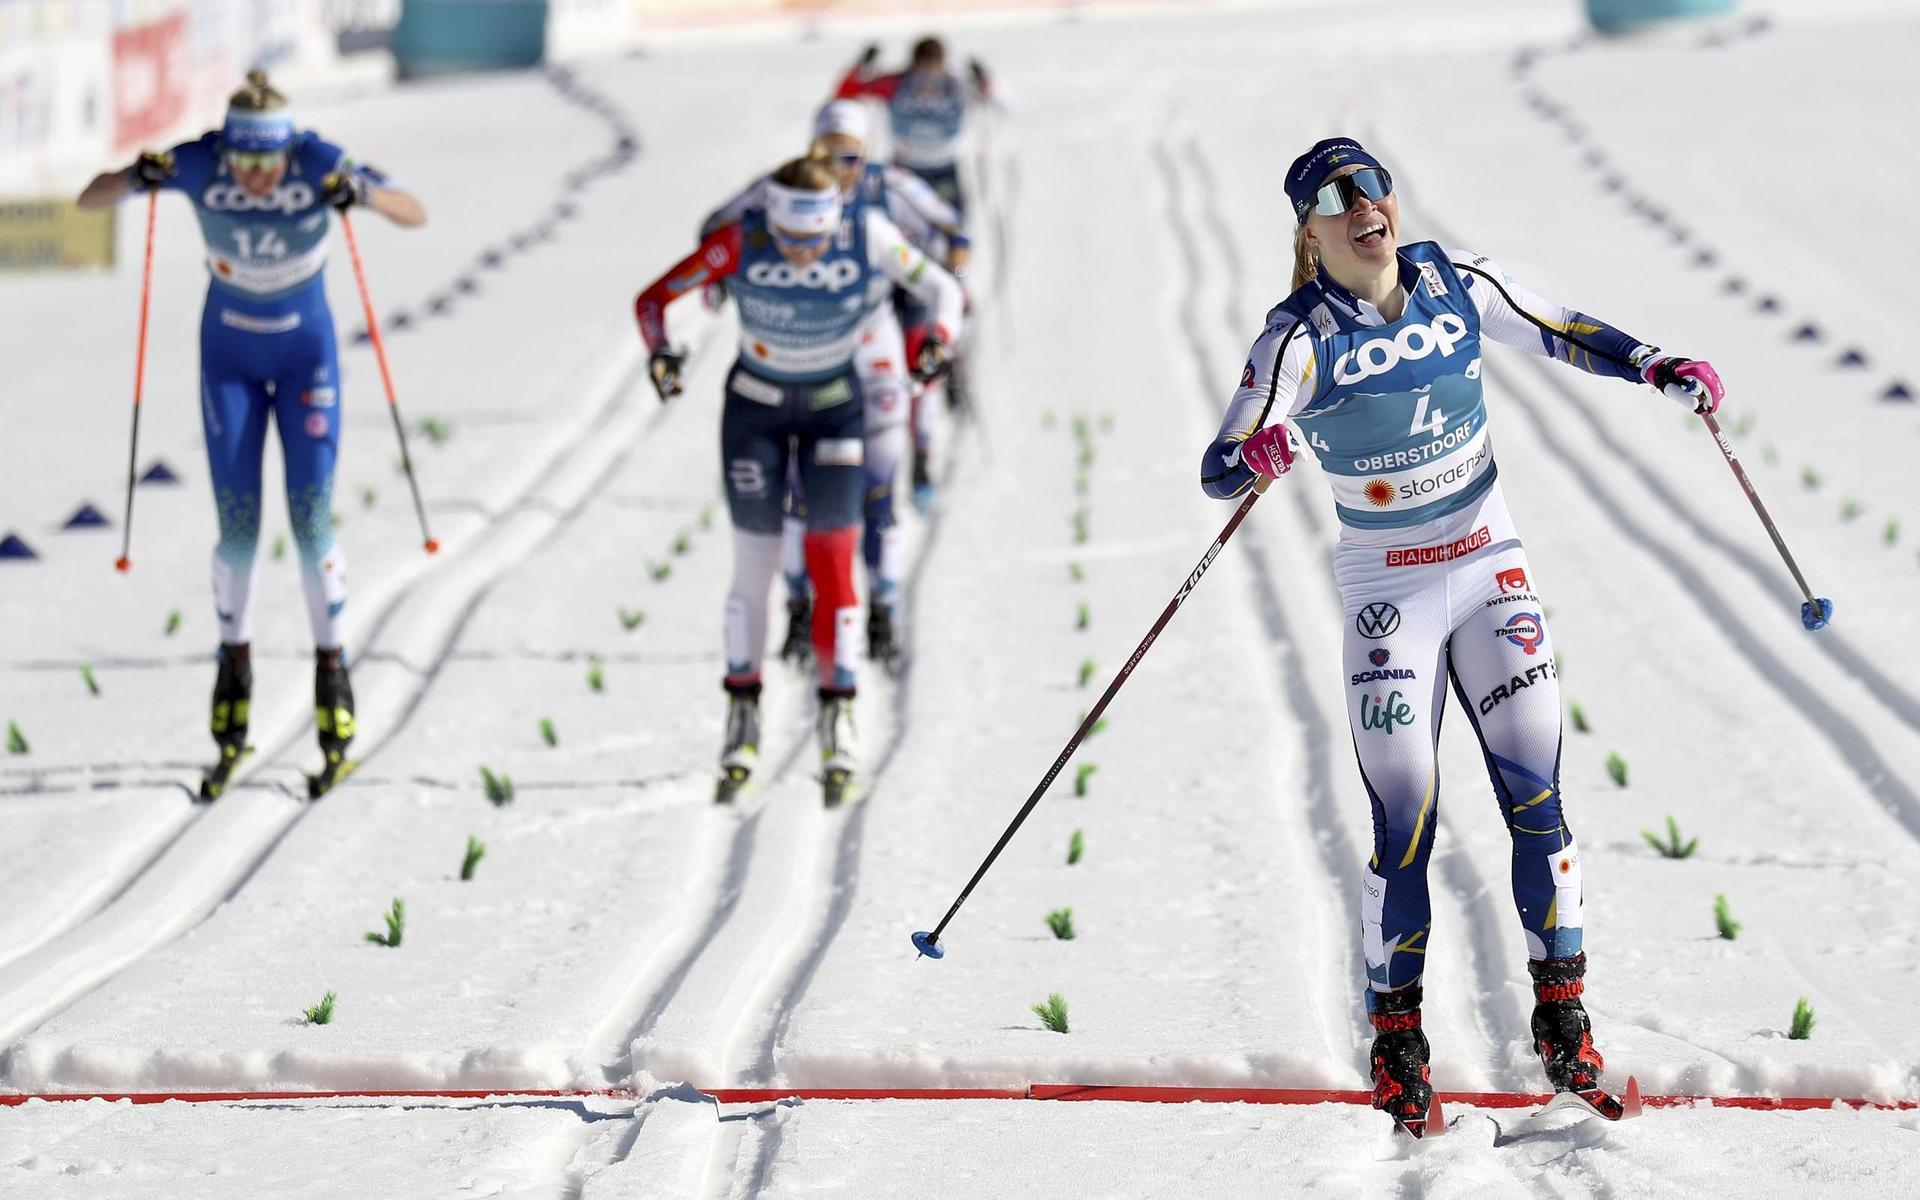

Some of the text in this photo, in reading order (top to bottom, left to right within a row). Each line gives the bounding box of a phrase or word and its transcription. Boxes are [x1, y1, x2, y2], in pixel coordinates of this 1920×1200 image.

[203, 181, 315, 215] coop
[231, 228, 287, 258] 14
[747, 258, 861, 293] coop
[1333, 313, 1468, 386] coop
[1408, 394, 1449, 438] 4
[1268, 444, 1287, 473] HESTRA
[1311, 431, 1330, 452] 4
[1354, 420, 1471, 472] OBERSTDORF
[1387, 526, 1491, 566] BAUHAUS
[1486, 594, 1529, 608] SVENSKA
[1494, 625, 1536, 638] Thermia
[1351, 669, 1416, 686] SCANIA
[1479, 662, 1548, 717] CRAFT
[1361, 690, 1416, 735] life
